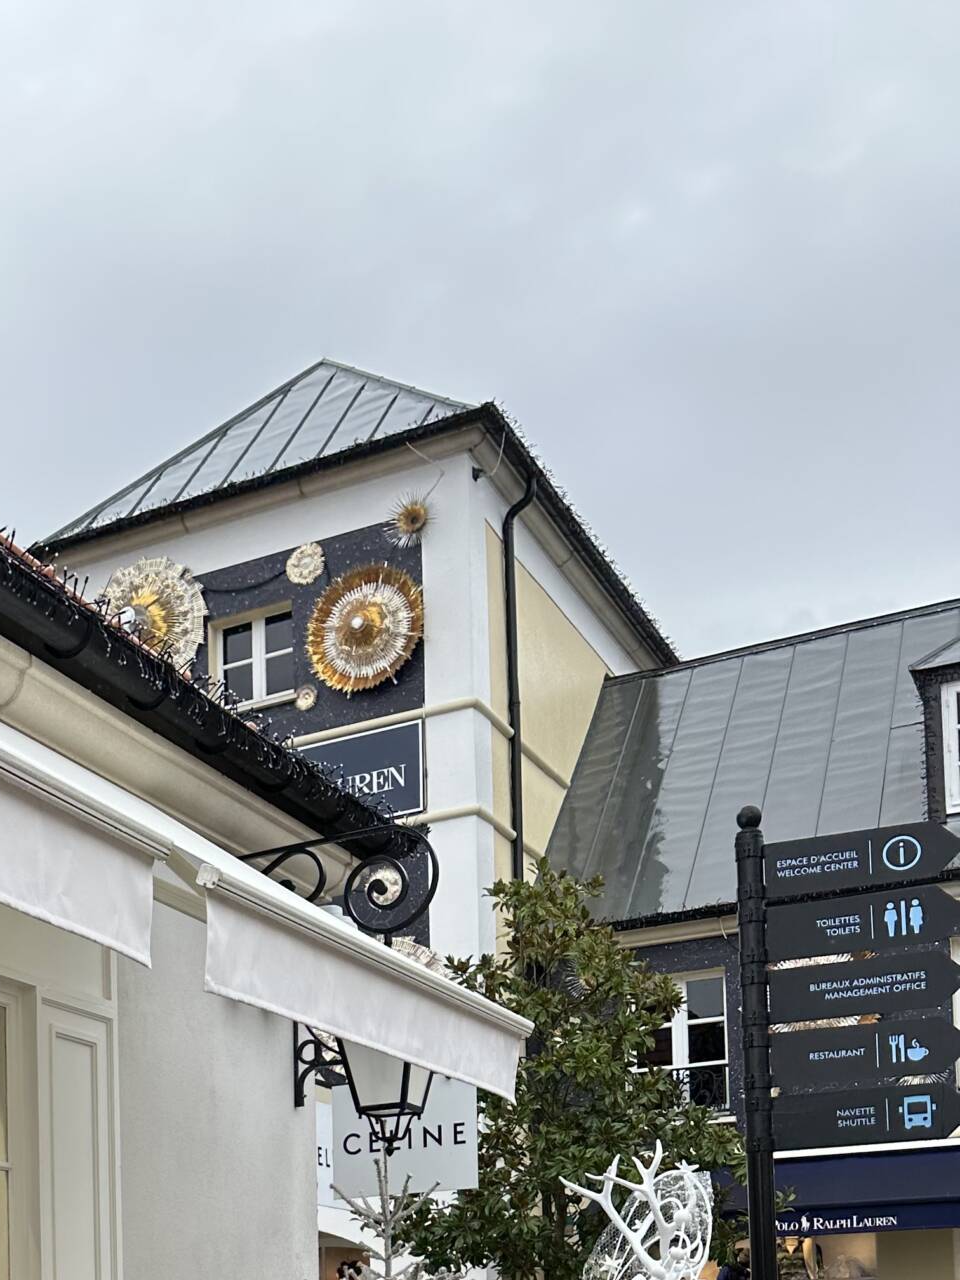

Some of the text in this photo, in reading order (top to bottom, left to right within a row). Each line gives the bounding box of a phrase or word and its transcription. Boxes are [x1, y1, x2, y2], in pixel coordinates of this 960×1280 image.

[777, 850, 858, 868] ESPACE D'ACCUEIL
[777, 861, 858, 878] WELCOME CENTER
[816, 915, 860, 927] TOILETTES
[826, 926, 860, 936] TOILETS
[809, 971, 926, 991] BUREAUX ADMINISTRATIFS
[825, 982, 926, 1000] MANAGEMENT OFFICE
[809, 1048, 866, 1060] RESTAURANT
[836, 1107, 875, 1117] NAVETTE
[837, 1117, 876, 1127] SHUTTLE
